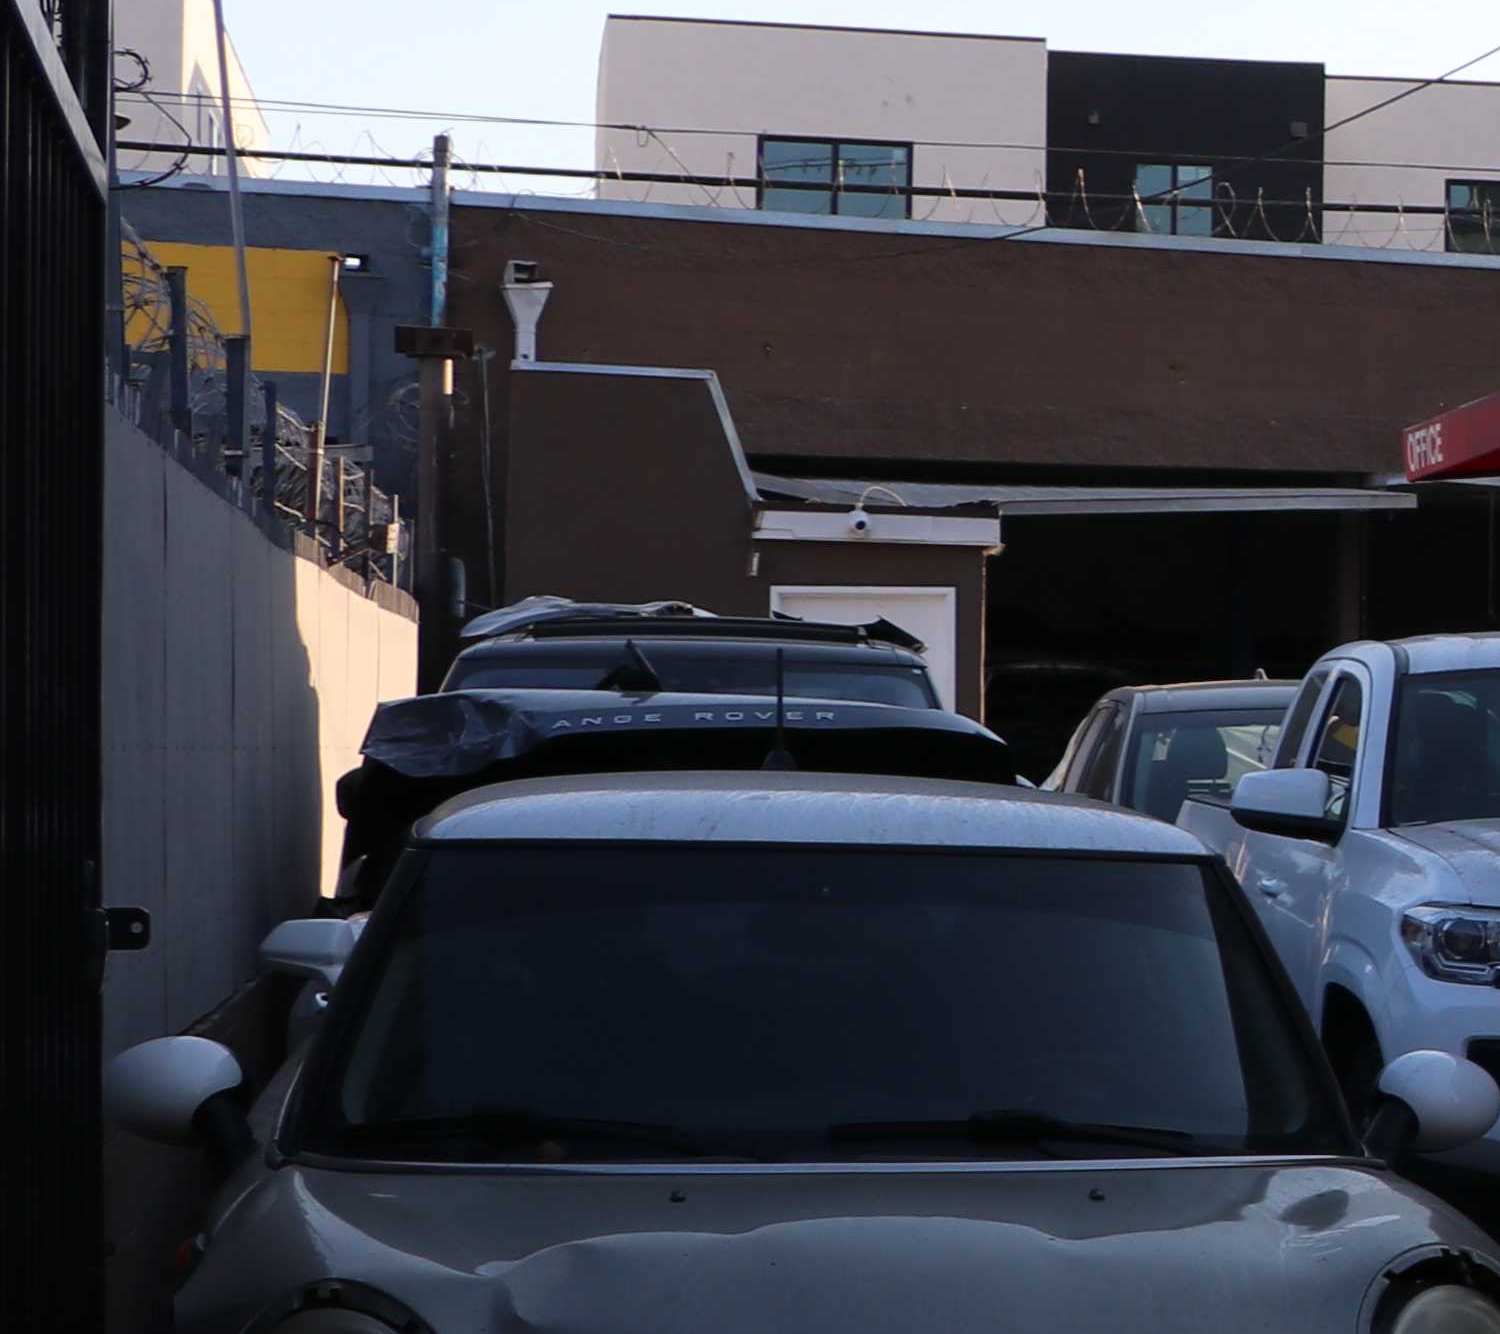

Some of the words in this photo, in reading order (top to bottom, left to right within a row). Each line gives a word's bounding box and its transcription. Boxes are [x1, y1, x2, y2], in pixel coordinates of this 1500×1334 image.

[1407, 422, 1444, 473] OFFICE
[551, 713, 662, 729] ANGE
[694, 711, 835, 721] ROVER
